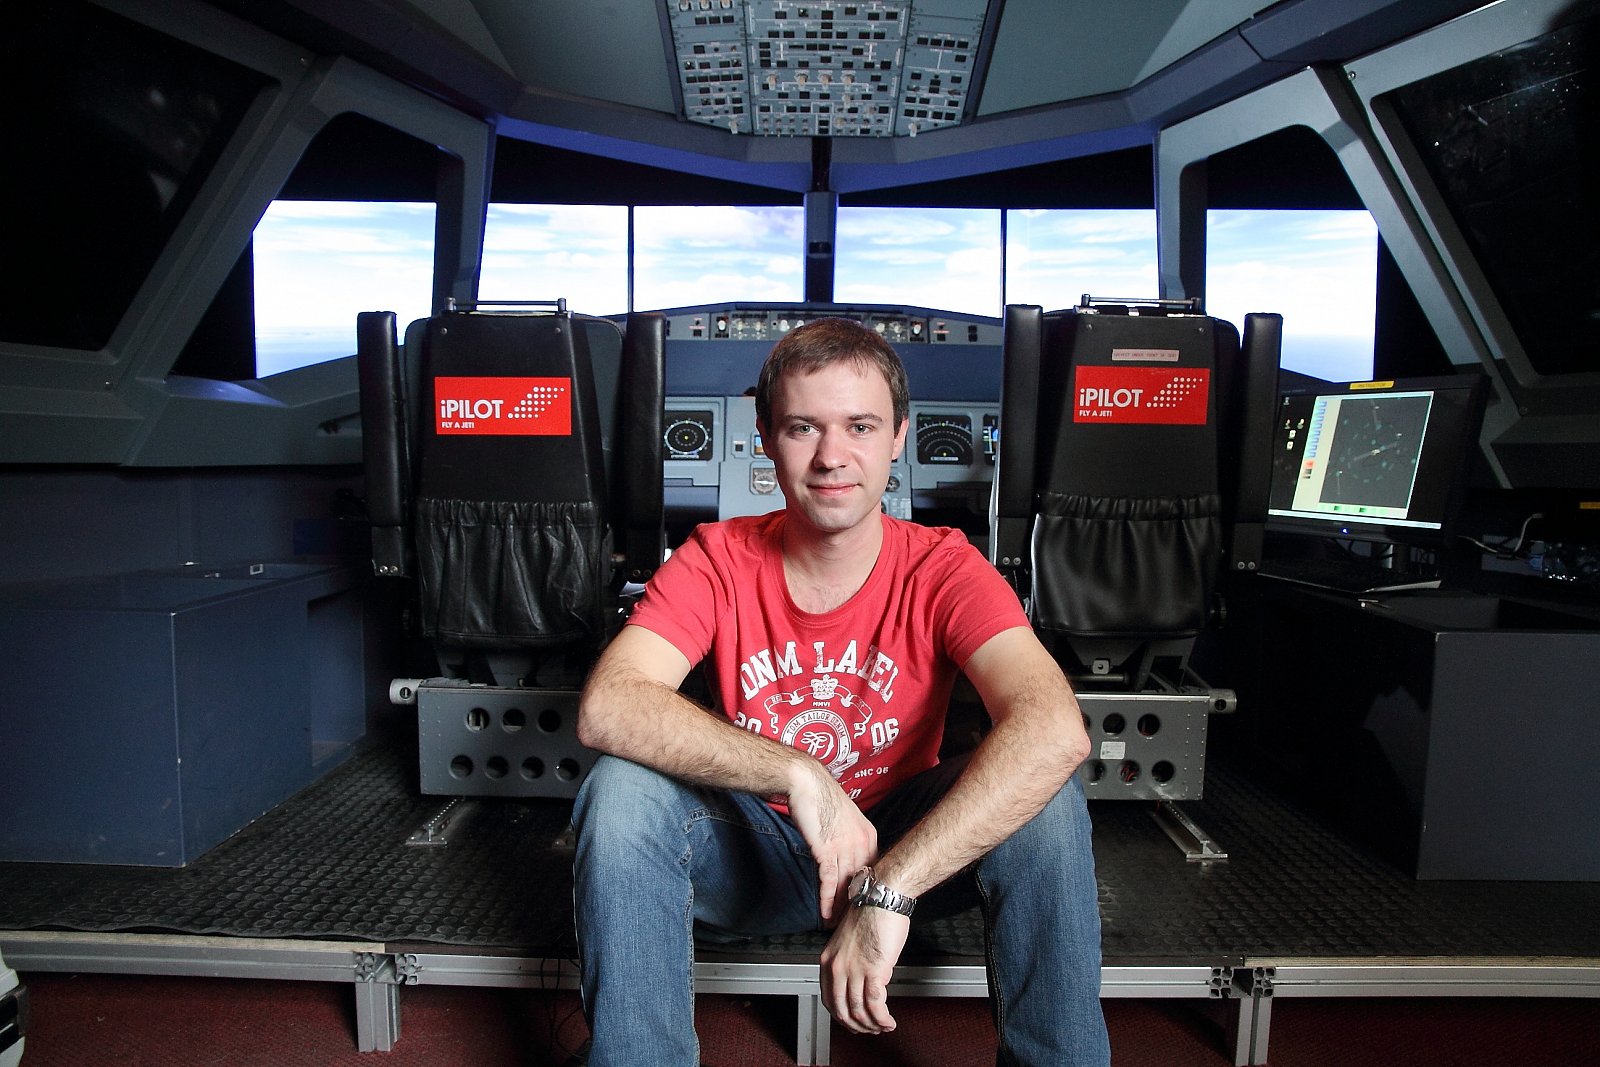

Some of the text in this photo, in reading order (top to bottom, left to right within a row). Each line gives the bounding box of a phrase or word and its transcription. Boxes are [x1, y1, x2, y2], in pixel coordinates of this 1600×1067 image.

[1079, 388, 1143, 408] iPILOT
[440, 399, 504, 419] iPILOT
[786, 720, 801, 735] TOM
[802, 711, 829, 722] TAILOR
[870, 718, 900, 747] 06
[854, 768, 874, 779] SNC
